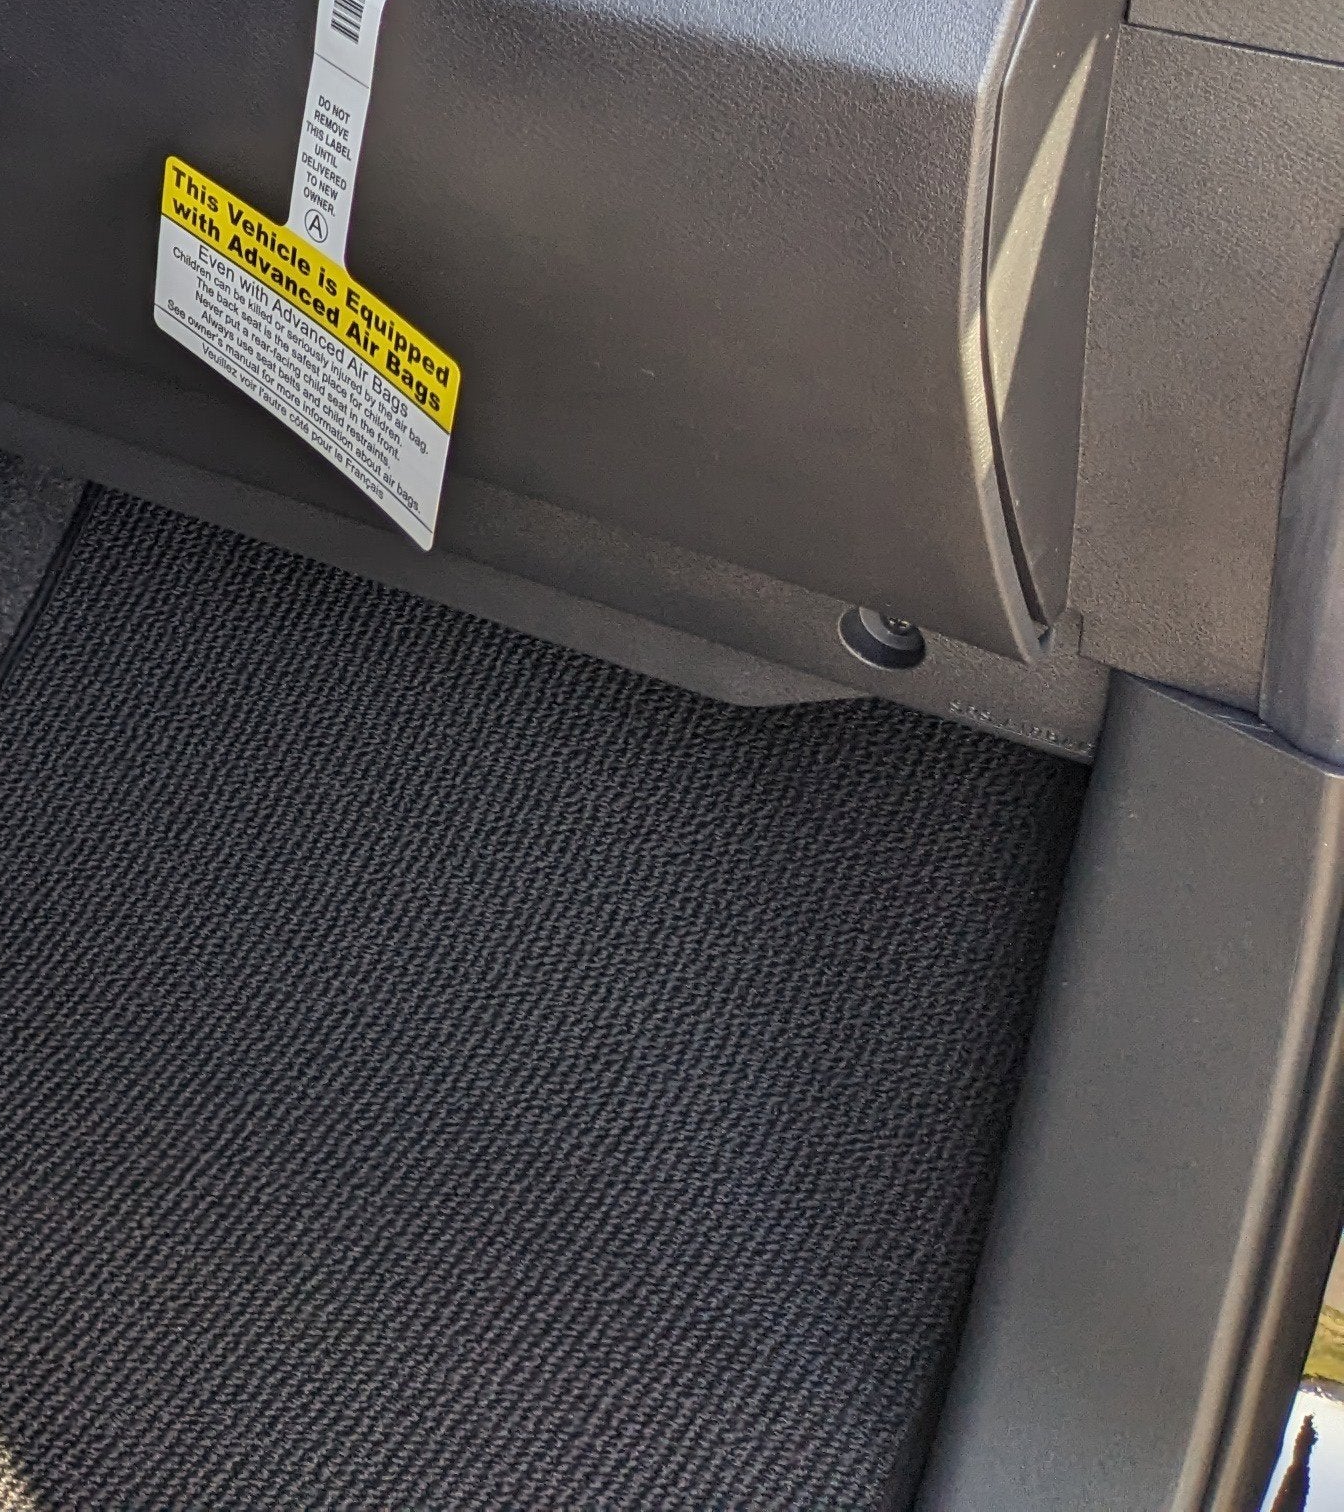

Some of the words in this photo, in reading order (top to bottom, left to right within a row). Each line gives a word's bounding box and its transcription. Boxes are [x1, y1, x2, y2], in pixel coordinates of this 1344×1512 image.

[302, 152, 347, 190] DELIVERED
[306, 120, 324, 142] THIS
[326, 134, 352, 161] LABEL
[306, 171, 318, 186] TO
[319, 182, 339, 201] NEW
[314, 110, 349, 142] REMOVE
[314, 144, 338, 169] UNTIL
[318, 95, 331, 111] DO
[332, 104, 351, 125] NOT
[172, 165, 219, 212] This
[228, 201, 311, 276] Vehicle
[318, 266, 337, 297] is
[346, 287, 450, 388] Equipped
[304, 186, 335, 217] OWNER.
[308, 214, 323, 239] A
[172, 198, 220, 243] with
[228, 234, 340, 328] Advanced
[346, 321, 380, 358] Air
[386, 349, 441, 412] Bags
[173, 246, 211, 281] Children
[214, 276, 231, 295] can
[234, 288, 246, 305] be
[248, 298, 273, 324] killed
[275, 320, 286, 333] or
[287, 330, 329, 369] seriously
[330, 362, 362, 396] injured
[364, 389, 376, 408] by
[378, 402, 393, 421] the
[394, 415, 408, 434] air
[409, 427, 429, 455] bag.
[196, 290, 224, 318] Never
[225, 313, 241, 332] put
[242, 327, 249, 337] a
[252, 332, 301, 379] rear-facing
[304, 372, 325, 397] child
[328, 392, 348, 415] seat
[350, 410, 358, 424] in
[360, 418, 375, 438] the
[377, 431, 400, 461] front.
[197, 276, 214, 298] The
[216, 290, 239, 316] back
[242, 311, 262, 333] seat
[264, 325, 272, 340] is
[275, 334, 289, 353] the
[292, 348, 320, 377] safest
[322, 372, 347, 399] place
[350, 392, 363, 411] for
[364, 408, 402, 447] children.
[198, 244, 235, 282] Even
[240, 276, 269, 307] with
[272, 298, 345, 364] Advanced
[346, 356, 369, 383] Air
[372, 375, 409, 419] Bags
[168, 299, 186, 320] See
[188, 316, 224, 348] owner's
[226, 344, 260, 375] manual
[262, 368, 275, 386] for
[277, 382, 301, 407] more
[303, 400, 354, 452] information
[356, 447, 382, 476] about
[383, 470, 396, 488] air
[396, 482, 421, 514] bags.
[201, 310, 234, 341] Always
[236, 337, 254, 356] use
[256, 352, 277, 373] seat
[279, 368, 301, 392] belts
[302, 388, 321, 408] and
[323, 404, 345, 428] child
[346, 424, 391, 470] restraints.
[202, 342, 238, 379] Veuillez
[240, 373, 258, 392] voir
[259, 386, 287, 416] l'autre
[290, 411, 310, 435] côté
[312, 431, 333, 454] pour
[334, 448, 343, 463] le
[345, 457, 384, 500] Français
